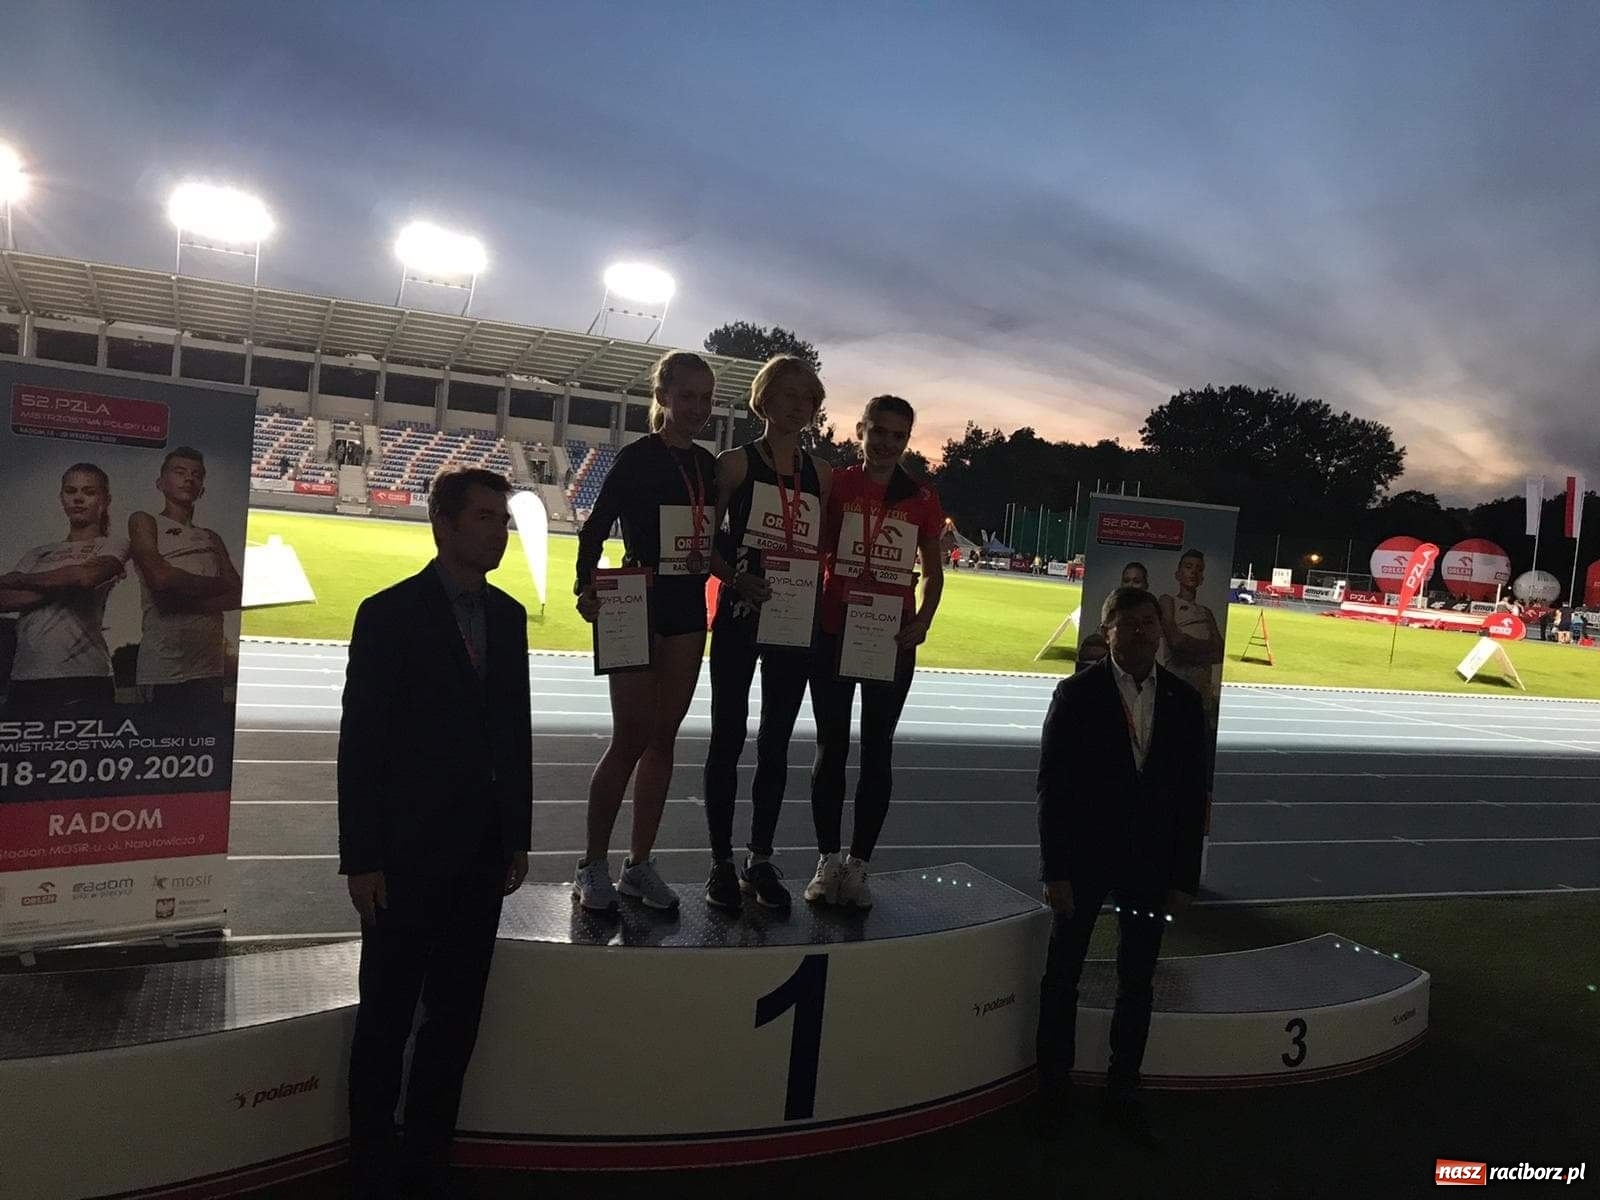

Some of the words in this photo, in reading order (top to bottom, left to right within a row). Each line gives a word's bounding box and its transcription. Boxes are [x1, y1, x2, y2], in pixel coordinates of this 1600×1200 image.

[21, 393, 110, 416] 52.PZLA
[768, 576, 813, 587] DYPLOM
[1405, 549, 1435, 589] PZLA
[1349, 593, 1377, 603] PZLA
[850, 610, 897, 622] DYPLOM
[0, 719, 139, 740] 52.PZLA
[0, 739, 125, 753] MISTRZOSTWA
[129, 737, 185, 749] POLSKI
[188, 736, 217, 747] U18
[0, 754, 214, 787] 18-20.09.2020
[48, 808, 163, 836] RADOM
[755, 953, 828, 1120] 1
[1282, 1018, 1307, 1067] 3
[251, 1074, 320, 1108] polanik
